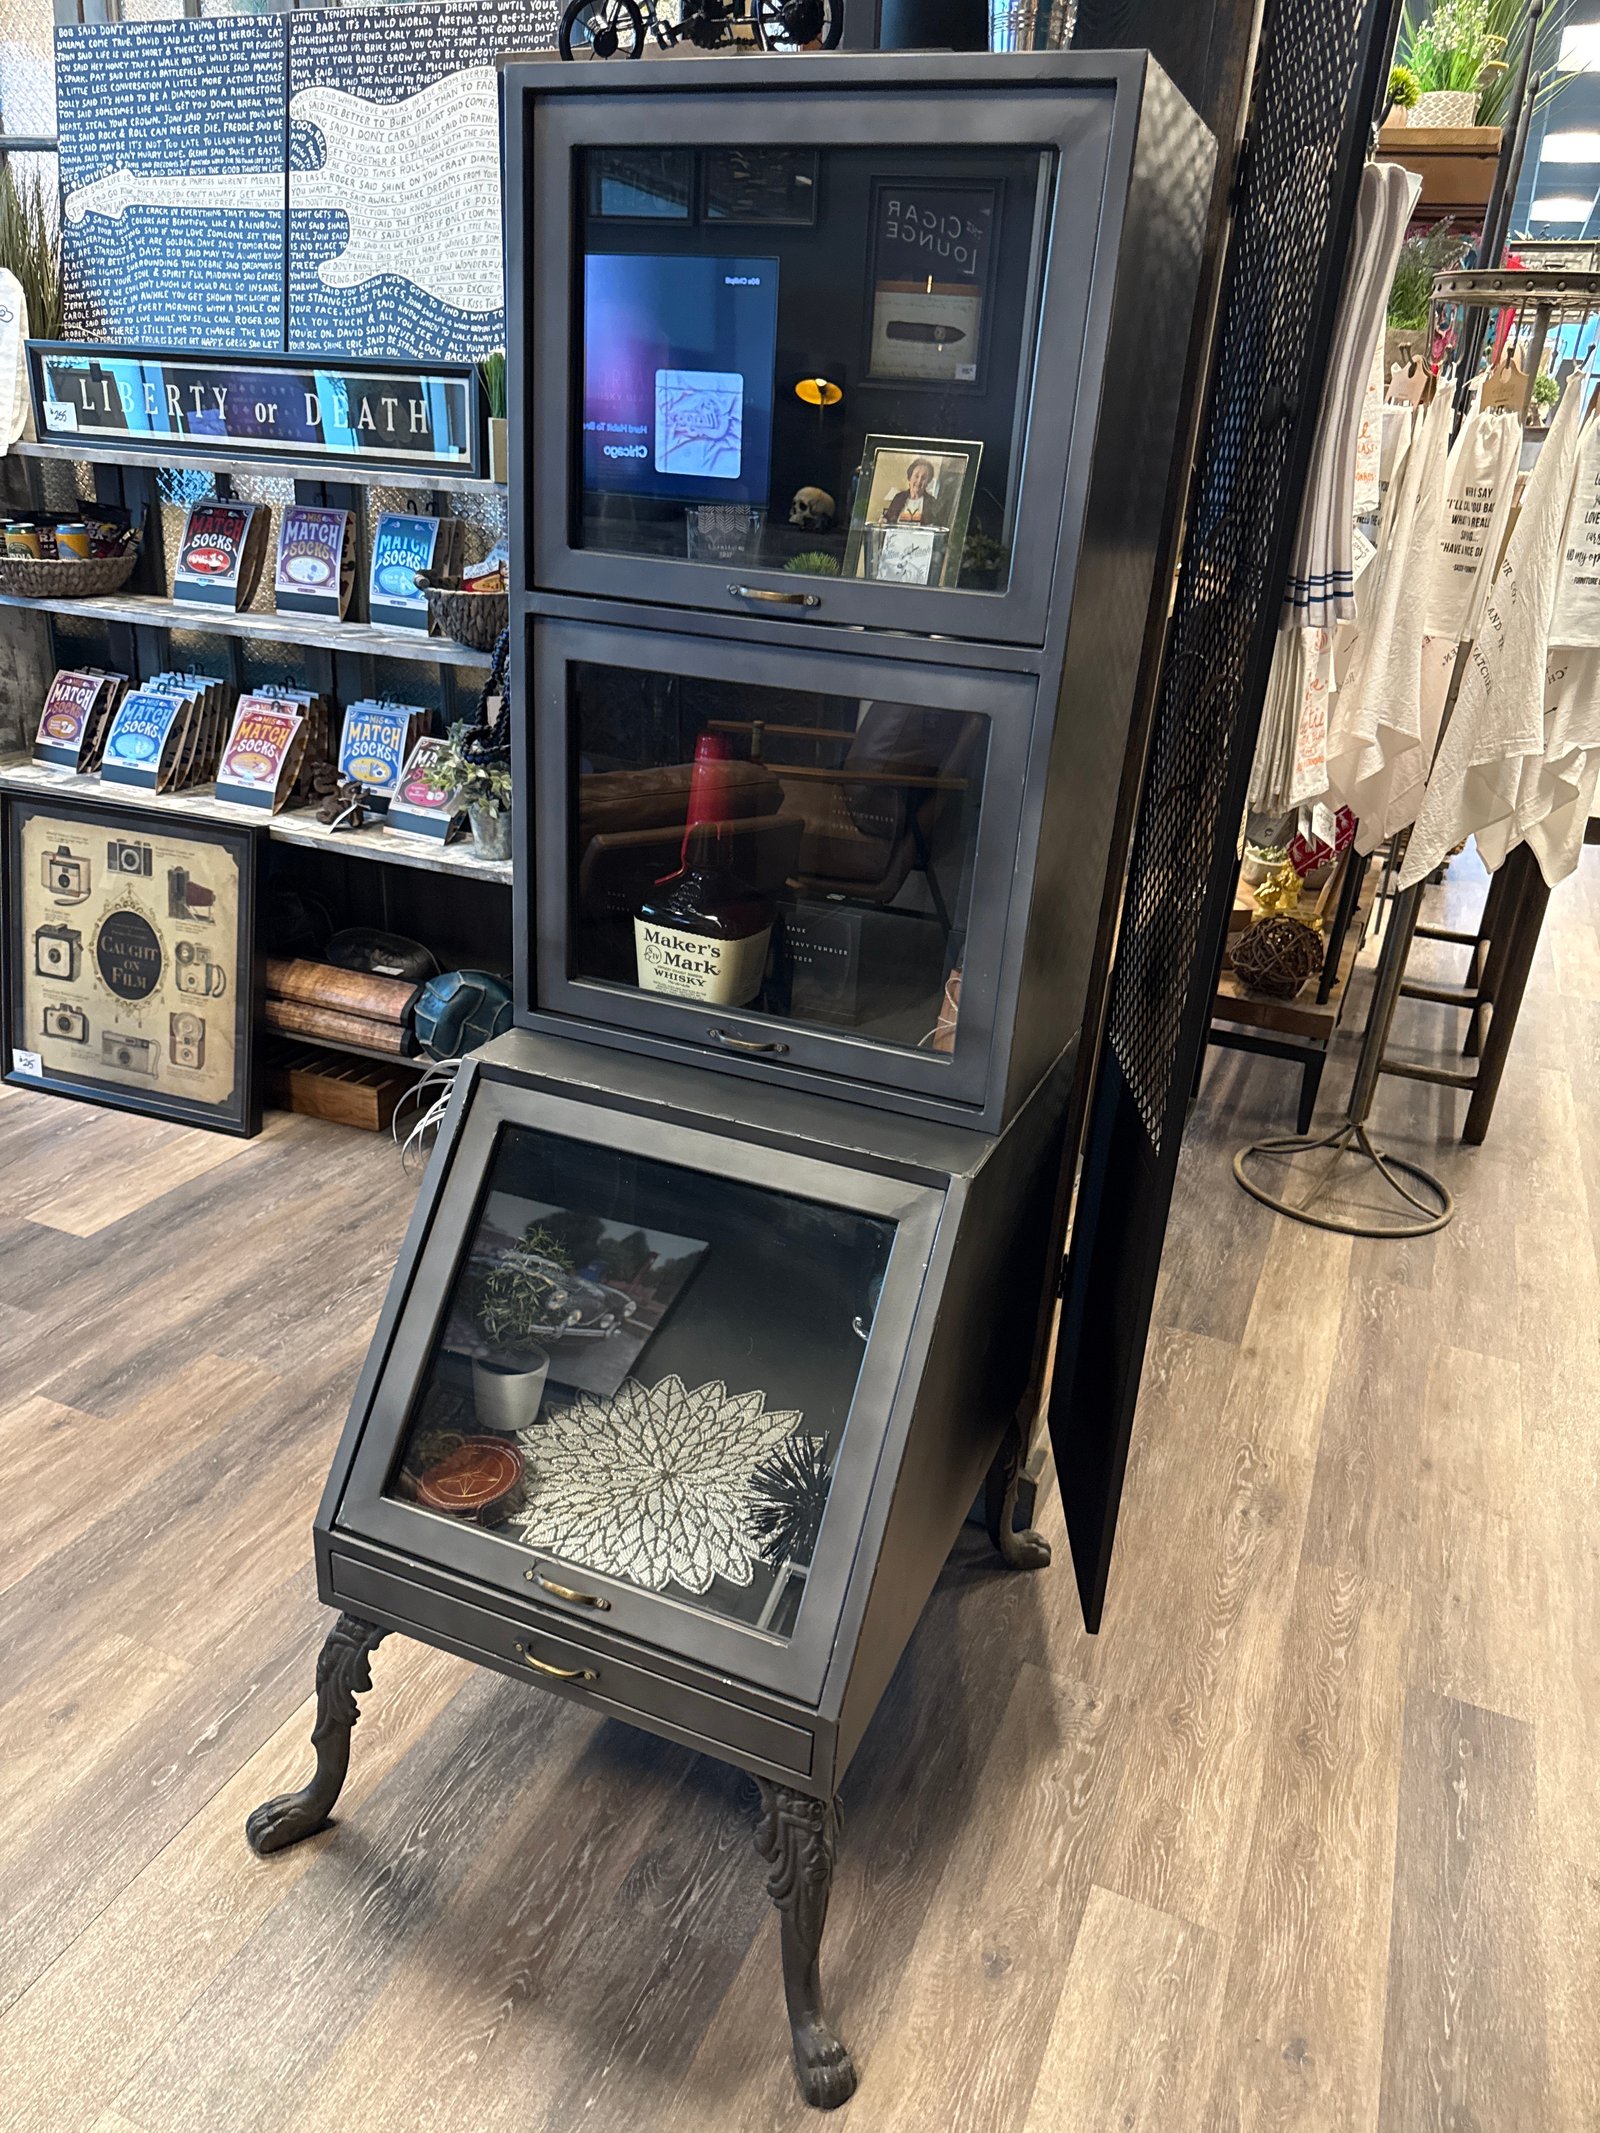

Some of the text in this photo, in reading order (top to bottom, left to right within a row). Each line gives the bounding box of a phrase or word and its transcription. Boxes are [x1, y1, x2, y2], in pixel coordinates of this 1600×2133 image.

[291, 0, 557, 22] LITTLE TENDERNESS, STEVEN SAID DREAM ON UNTIL YOUR
[58, 27, 74, 38] BOB
[78, 26, 97, 37] SAID
[100, 24, 124, 36] DON'T
[126, 24, 153, 35] WORRY
[153, 23, 177, 33] ABOUT
[179, 22, 186, 33] A
[216, 18, 235, 29] OTIS
[237, 17, 254, 28] SAID
[256, 16, 273, 26] TRY
[276, 17, 282, 26] A
[292, 14, 498, 34] SAID BABY, IT'S A WILD WORLD. ARETHA SAID
[57, 28, 283, 51] DREAMS COME TRUE. DAVID SAID WE CAN BE HEROES. CAT
[291, 57, 313, 68] DON'T
[316, 57, 329, 66] LET
[332, 55, 353, 65] YOUR
[355, 54, 383, 64] BABIES
[387, 52, 413, 63] GROW
[416, 51, 427, 61] UP
[430, 51, 441, 59] TO
[445, 49, 455, 59] BE
[58, 73, 284, 97] A LITTLE LESS CONVERSATION A LITTLE MORE ACTION PLEASE.
[60, 134, 76, 143] NEIL
[78, 132, 95, 141] SAID
[98, 130, 117, 140] ROCK
[128, 128, 147, 138] ROLL
[150, 127, 167, 137] CAN
[170, 124, 200, 135] NEVER
[204, 123, 221, 134] DIE.
[223, 122, 254, 133] FREDDIE
[256, 121, 271, 131] SAID
[273, 119, 283, 131] BE
[440, 156, 467, 172] CRAZY
[292, 174, 302, 183] TO
[329, 173, 355, 187] ROGER
[359, 181, 378, 191] SAID
[382, 181, 406, 192] SHINE
[63, 303, 280, 321] CAROLE SAID GET UP EVERY MORNING WITH A SMILE ON
[290, 299, 395, 317] YOUR FACE. KENNY SAID
[289, 316, 307, 327] ALL
[312, 317, 329, 327] YOU
[332, 317, 363, 327] TOUCH
[379, 311, 392, 321] ALL
[92, 325, 280, 338] SAID THERE'S STILL TIME TO CHANGE THE ROAD
[290, 328, 317, 338] YOU'RE
[337, 329, 364, 338] DAVID
[366, 324, 385, 335] SAID
[358, 347, 384, 357] CARRY
[78, 378, 429, 434] LIBERTY or DEATH
[1478, 488, 1493, 498] SAY
[189, 514, 245, 542] MATCH
[284, 520, 340, 549] MATCH
[191, 533, 233, 552] SOCKS
[289, 541, 330, 560] SOCKS
[382, 550, 421, 571] SOCKS
[1487, 607, 1502, 632] AND
[50, 684, 93, 710] MATCH
[120, 703, 173, 730] MATCH
[121, 720, 159, 738] SOCKS
[236, 720, 291, 749] MATCH
[347, 721, 402, 751] MATCH
[237, 739, 277, 758] SOCKS
[352, 742, 392, 762] SOCKS
[101, 936, 158, 961] CAUGHT
[643, 928, 721, 958] Maker's
[813, 944, 849, 956] TUMBLER
[124, 960, 140, 971] ON
[663, 951, 721, 976] Mark
[112, 966, 147, 990] FILM
[654, 967, 707, 987] WHISKY
